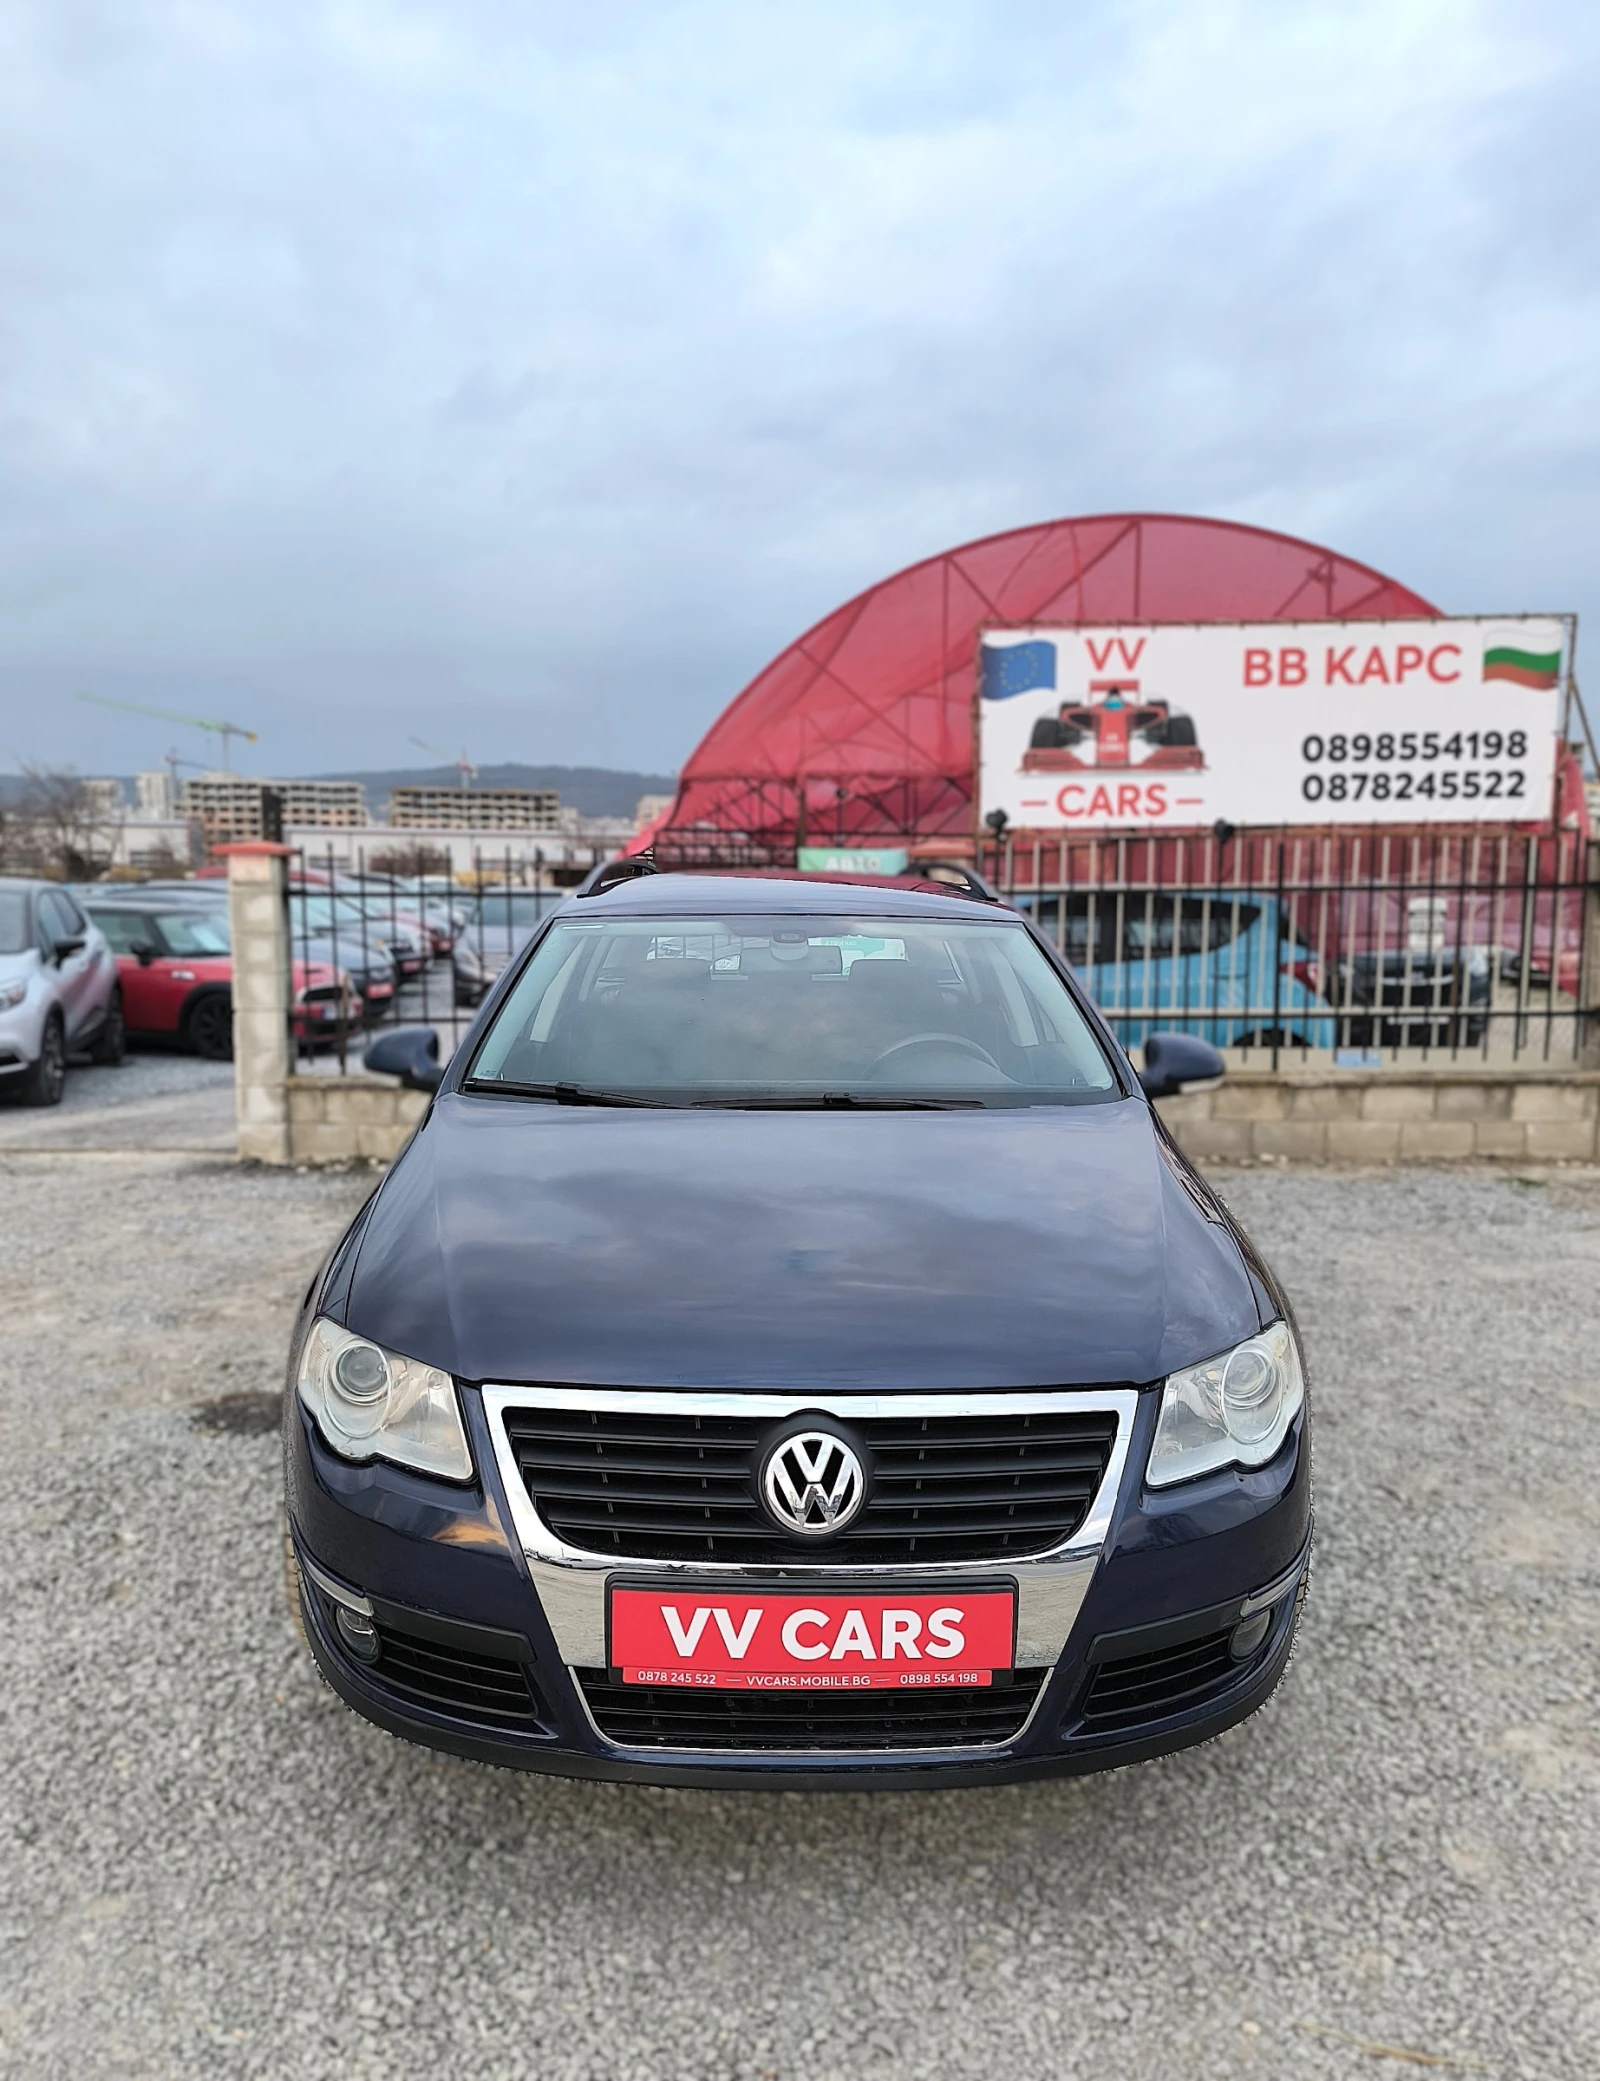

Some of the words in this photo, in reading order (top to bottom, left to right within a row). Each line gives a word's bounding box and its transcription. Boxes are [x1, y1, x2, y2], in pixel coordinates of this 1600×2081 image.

[1084, 637, 1147, 672] VV
[1324, 643, 1462, 685] КАРС
[1302, 730, 1528, 763] 0898554198
[1055, 783, 1168, 818] CARS
[1302, 770, 1526, 802] 0878245522
[660, 1606, 764, 1659] VV
[781, 1607, 966, 1660] CARS
[637, 1670, 668, 1682] 0878
[670, 1672, 692, 1684] 245
[694, 1673, 716, 1685] 522
[746, 1675, 871, 1686] VVCARS.MOBILE.BG
[899, 1674, 931, 1685] 0898
[933, 1673, 955, 1684] 554
[957, 1672, 978, 1683] 198
